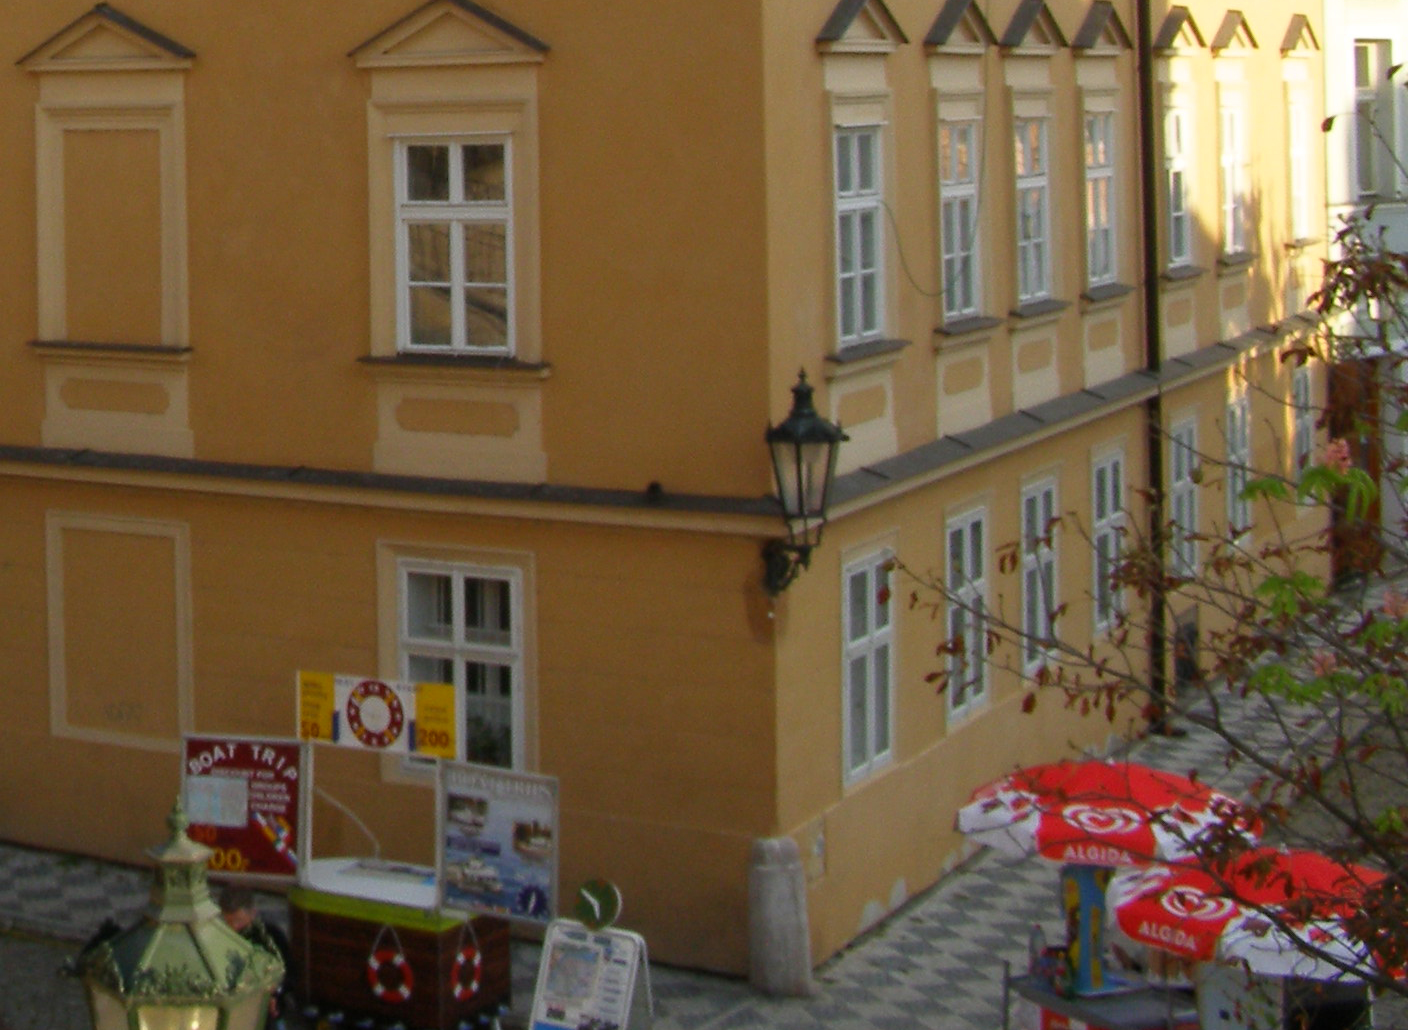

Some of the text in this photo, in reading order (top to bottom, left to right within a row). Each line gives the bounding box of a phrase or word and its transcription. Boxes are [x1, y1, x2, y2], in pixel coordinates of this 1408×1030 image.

[189, 743, 297, 781] BOAT TRIP
[1064, 845, 1133, 864] ALGIDA
